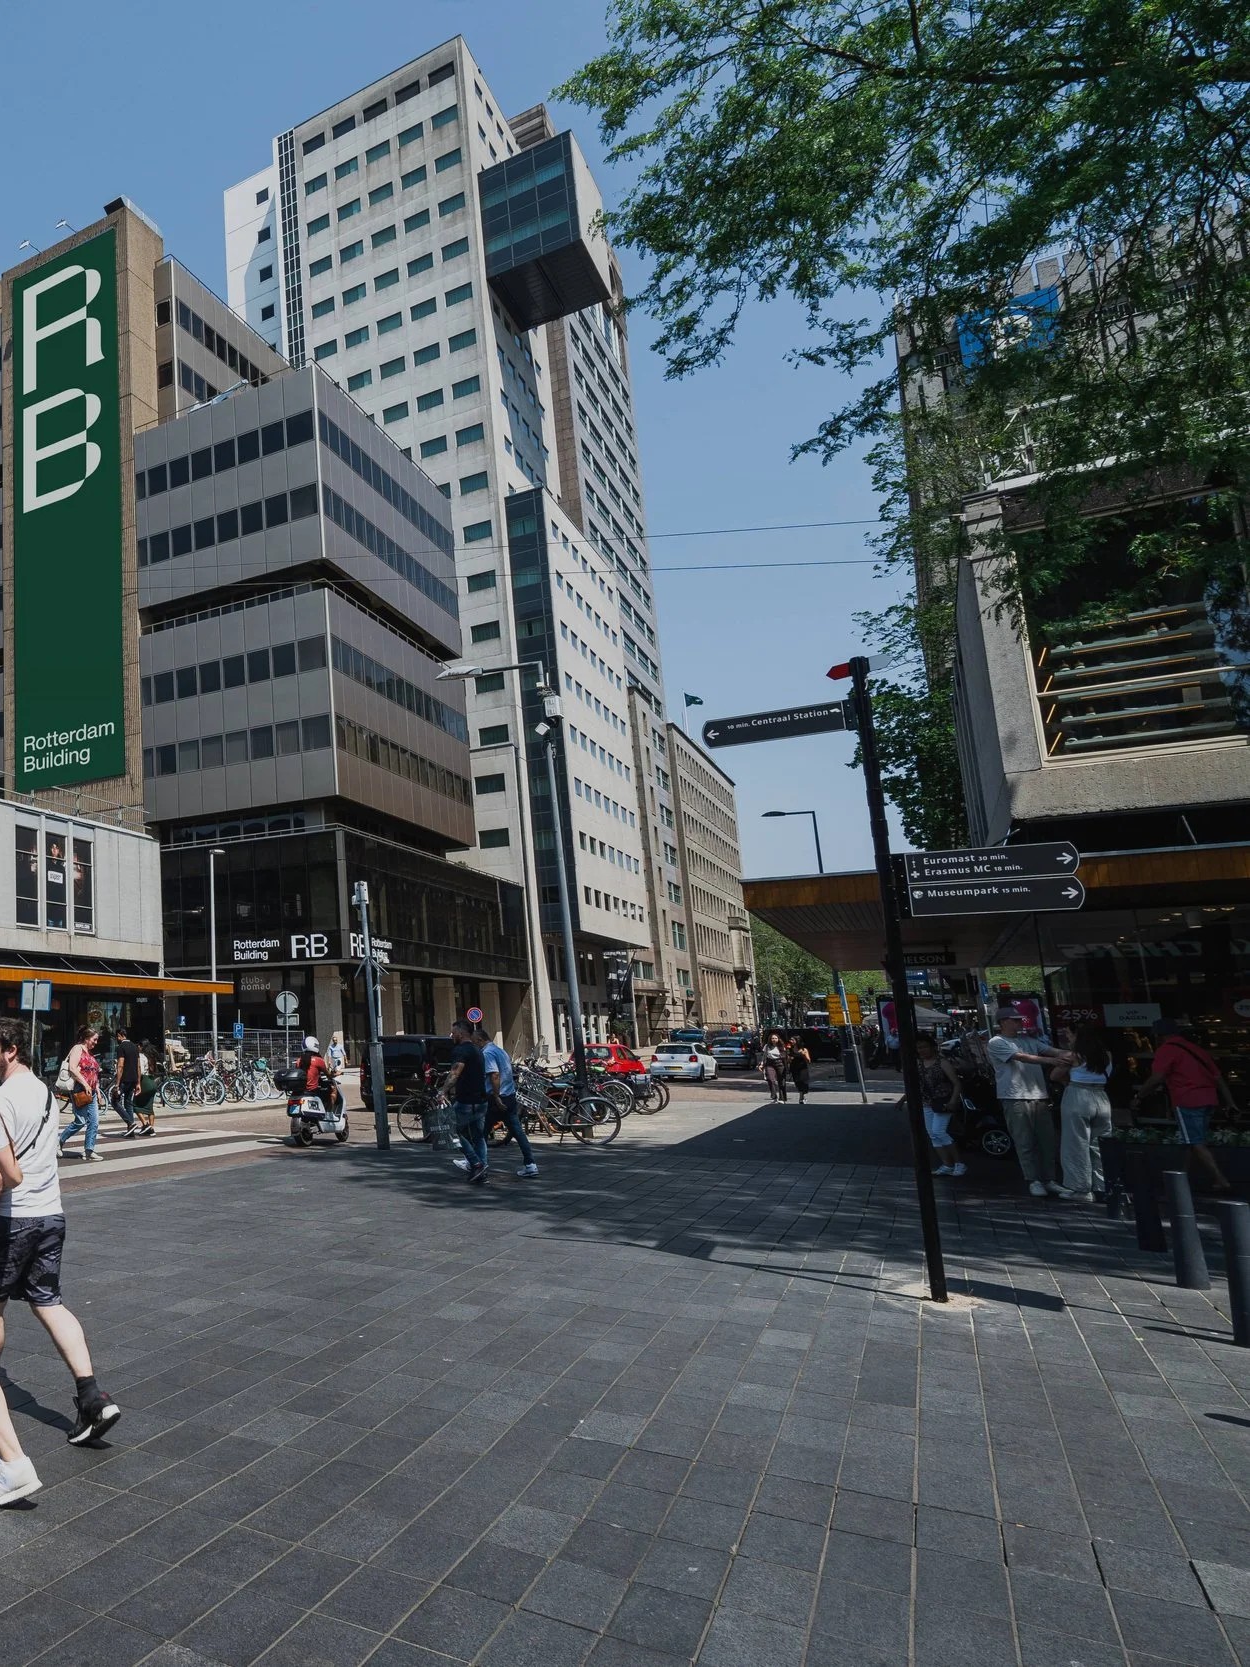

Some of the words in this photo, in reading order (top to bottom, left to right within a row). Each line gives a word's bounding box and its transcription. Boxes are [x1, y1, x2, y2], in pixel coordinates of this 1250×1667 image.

[736, 721, 750, 729] min.
[751, 714, 791, 727] Centraal
[793, 709, 829, 721] Station
[23, 721, 115, 753] Rotterdam
[23, 747, 90, 773] Building
[923, 855, 976, 865] Euromast
[924, 866, 971, 876] Erasmus
[973, 864, 991, 873] MC
[1004, 863, 1023, 871] min.
[927, 886, 999, 897] Museumpark
[233, 938, 280, 950] Rotterdam
[291, 933, 329, 959] RB
[234, 949, 269, 961] Building
[241, 981, 271, 991] nomad
[1056, 1009, 1098, 1021] -25%
